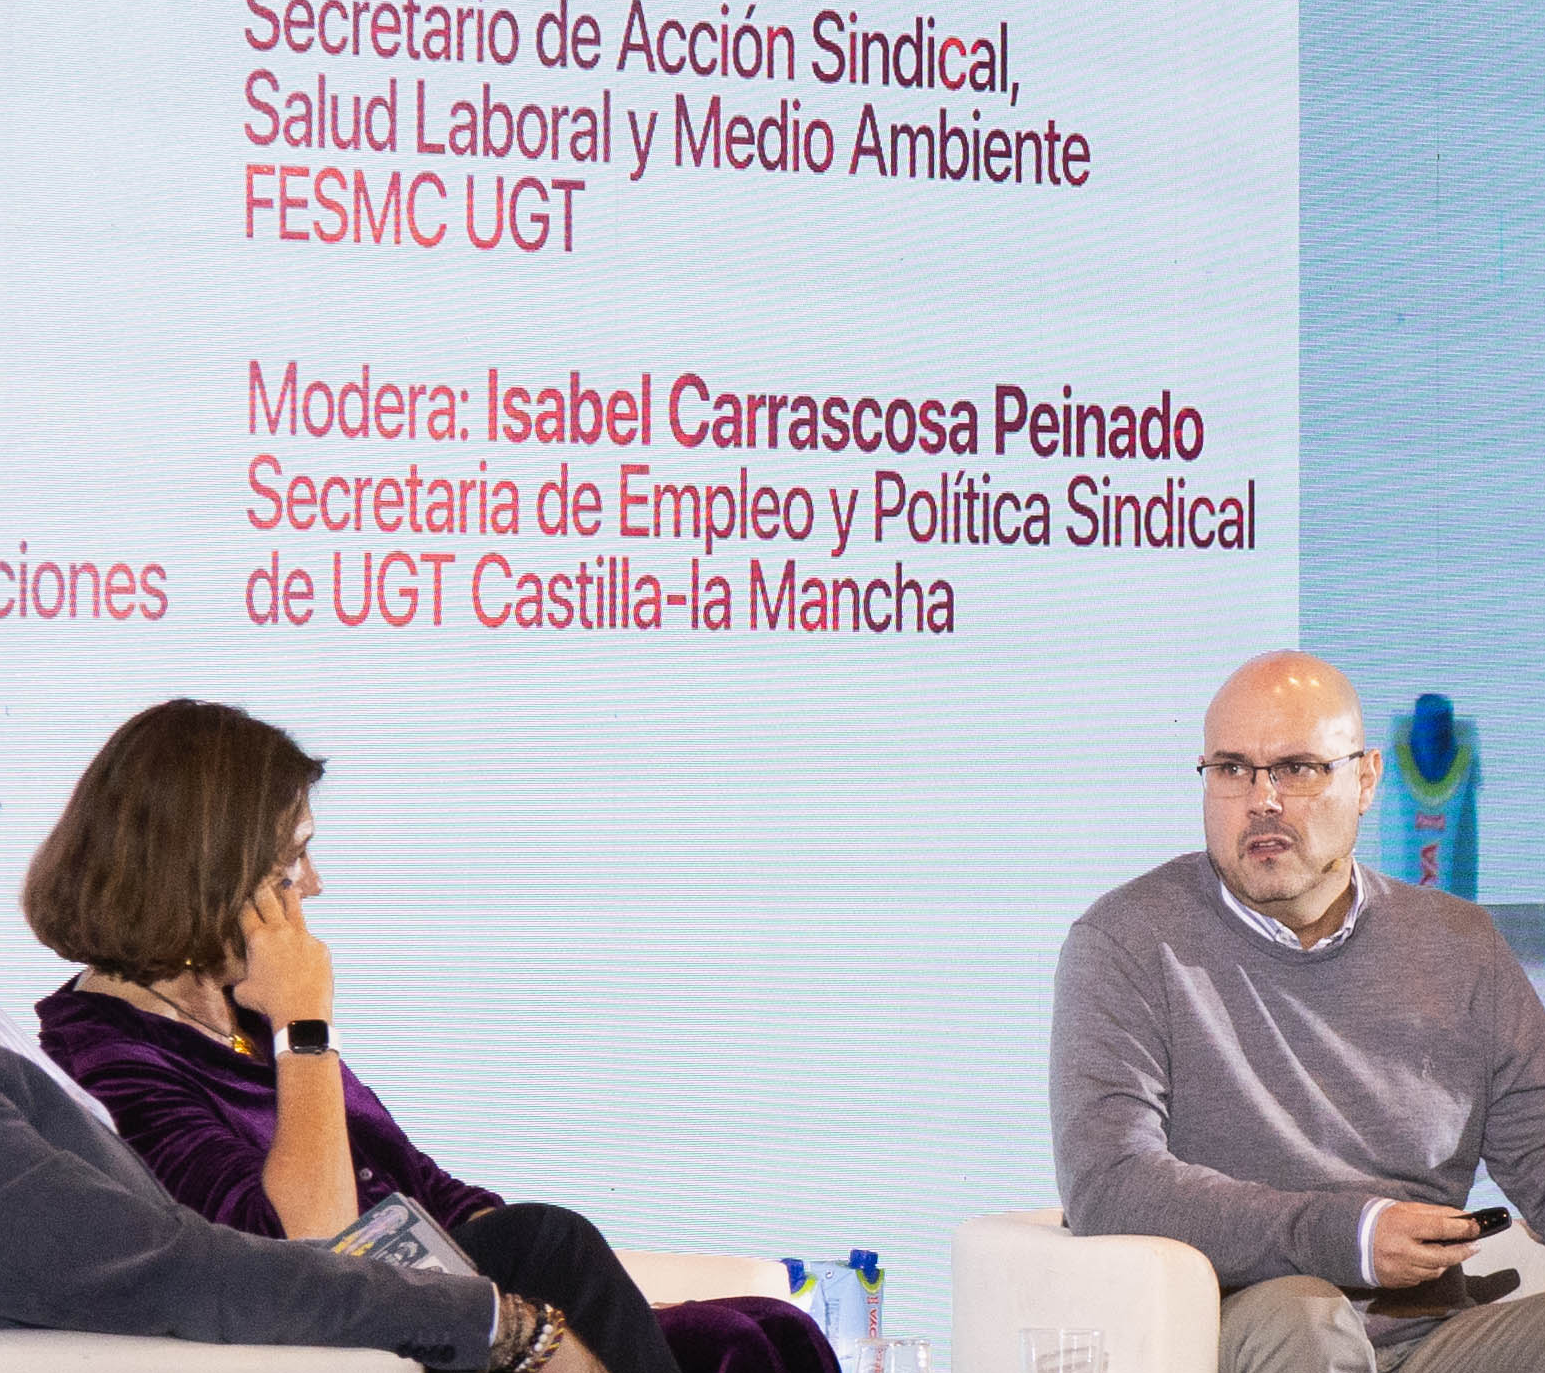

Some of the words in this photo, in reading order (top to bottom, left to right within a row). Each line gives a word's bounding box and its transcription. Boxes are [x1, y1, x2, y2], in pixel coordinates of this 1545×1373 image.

[617, 0, 795, 80] Acción
[811, 9, 1020, 105] Sindical,
[245, 69, 397, 152] Salud
[417, 80, 611, 162] Laboral
[628, 111, 657, 181] y
[675, 93, 835, 174] Medio
[849, 103, 1091, 187] Ambiente
[246, 164, 446, 248] FESMC
[467, 176, 586, 252] UGT
[249, 361, 469, 440] Modera:
[488, 368, 652, 446] Isabel
[668, 372, 979, 456] Carrascosa
[994, 383, 1205, 462] Peinado
[248, 454, 519, 535] Secretaria
[537, 463, 602, 537] de
[620, 464, 815, 555] Empleo
[829, 489, 859, 558] y
[874, 469, 1051, 546] Política
[1066, 474, 1256, 550] Sindical
[246, 553, 314, 626] de
[334, 551, 455, 627] UGT
[472, 553, 732, 631] Castilla-la
[749, 559, 955, 634] Mancha
